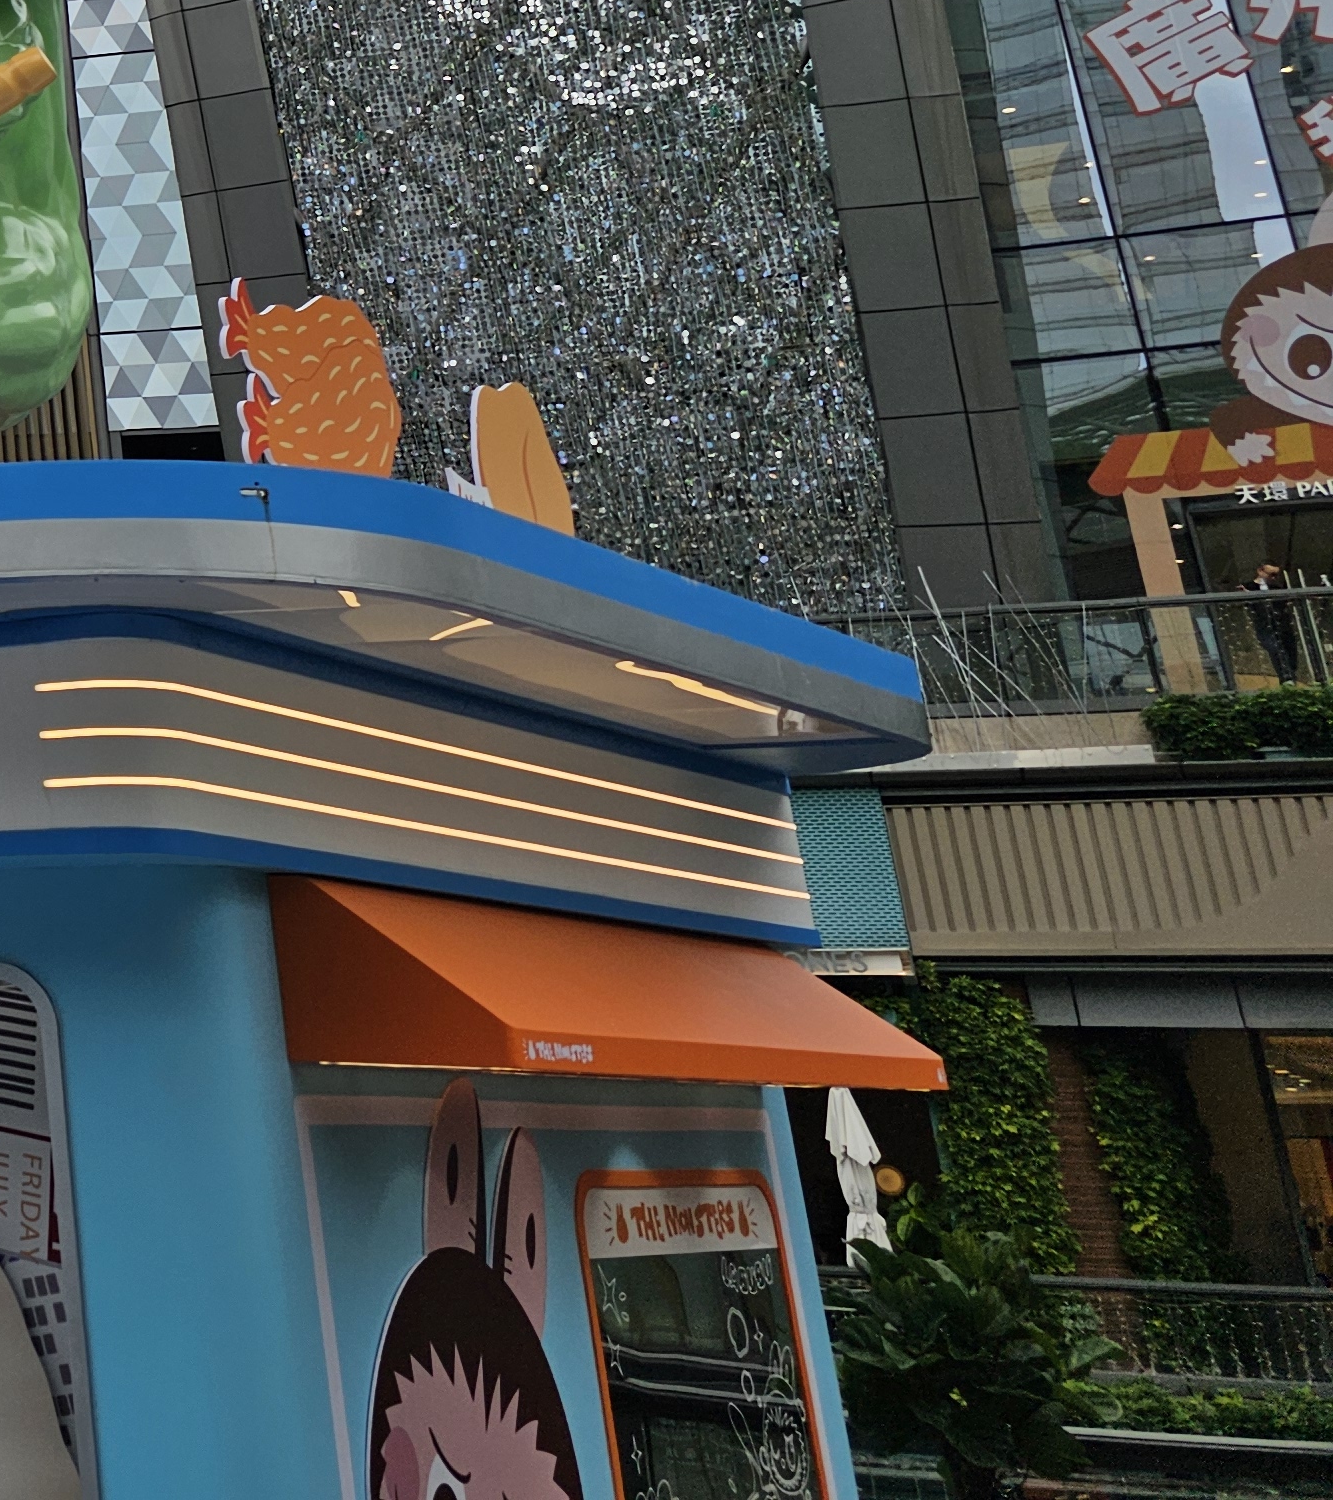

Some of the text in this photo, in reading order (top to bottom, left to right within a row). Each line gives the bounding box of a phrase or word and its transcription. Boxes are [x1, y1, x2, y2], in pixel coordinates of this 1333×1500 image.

[19, 1153, 43, 1266] FRIDAY
[629, 1199, 735, 1243] THE MONSTERS
